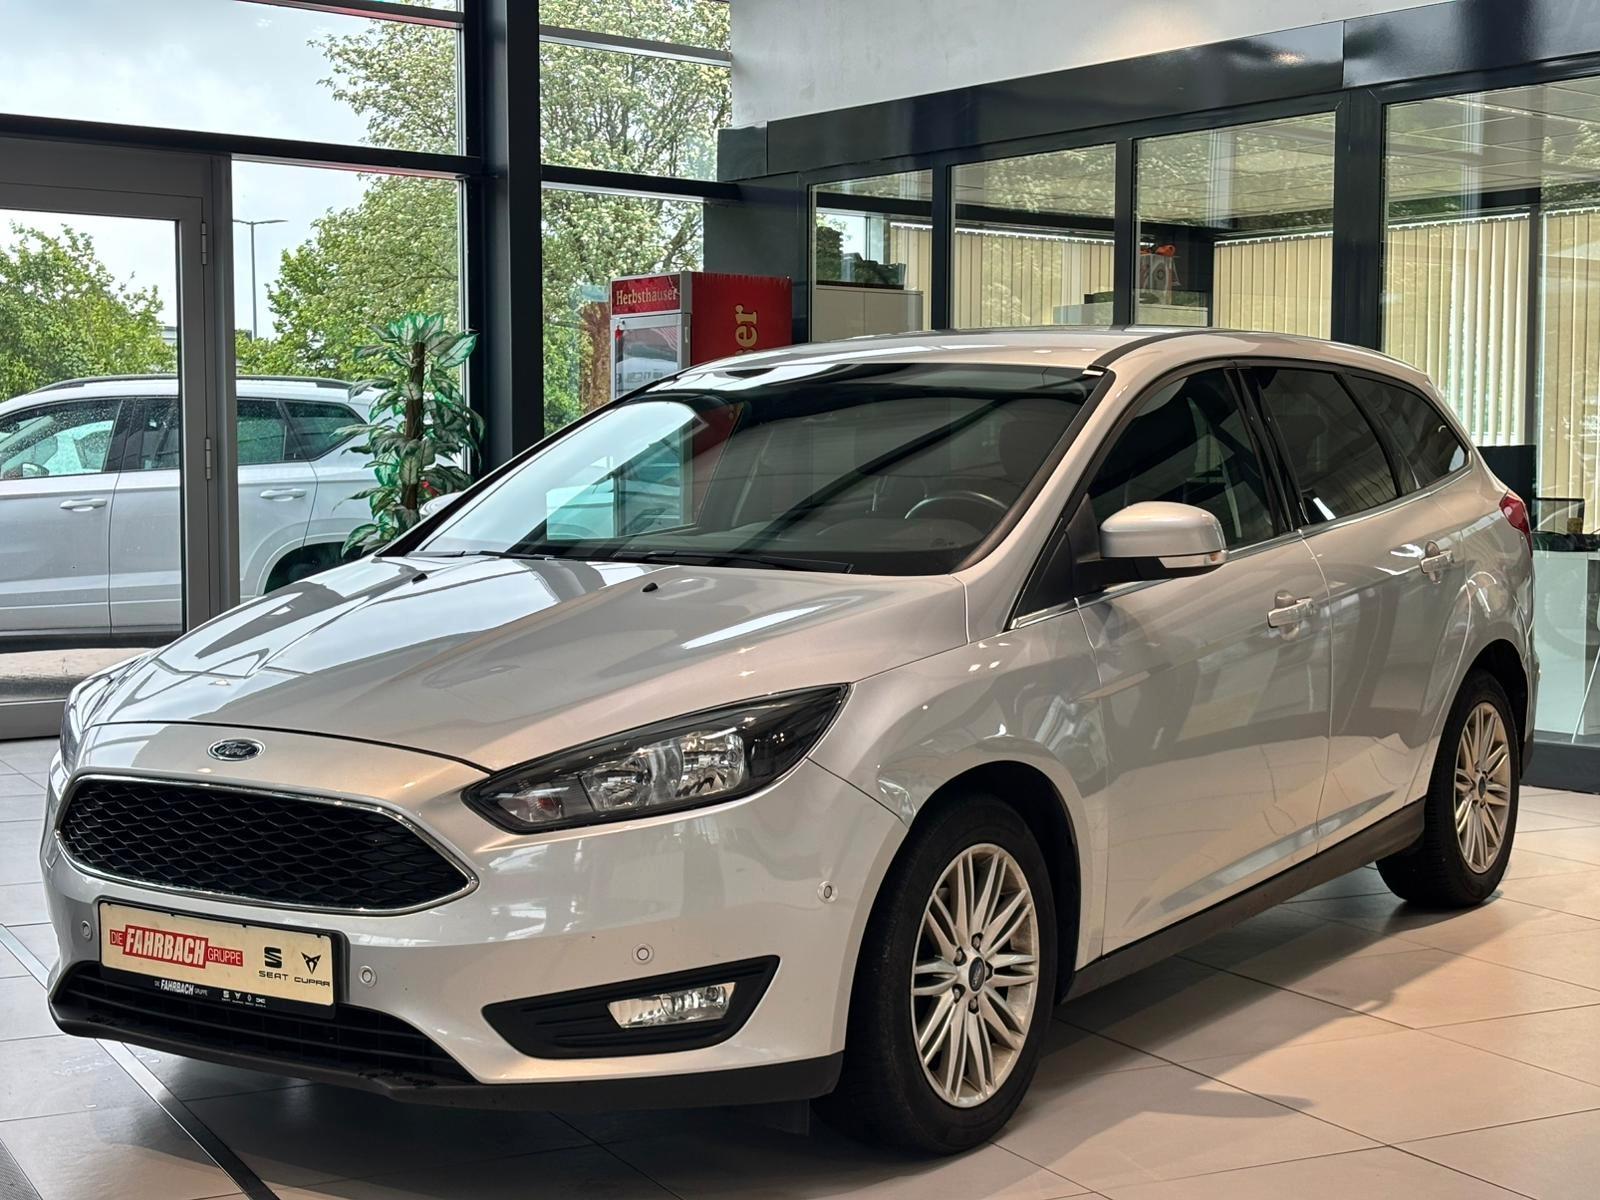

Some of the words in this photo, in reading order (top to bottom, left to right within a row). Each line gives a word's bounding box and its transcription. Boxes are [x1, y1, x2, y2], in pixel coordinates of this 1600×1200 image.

[111, 930, 123, 945] DIE
[125, 928, 206, 966] FAHRBACH
[207, 948, 242, 965] GRUPPE
[259, 970, 289, 982] SEAT
[294, 976, 331, 987] CUPRA
[160, 979, 195, 996] FAHRBACH
